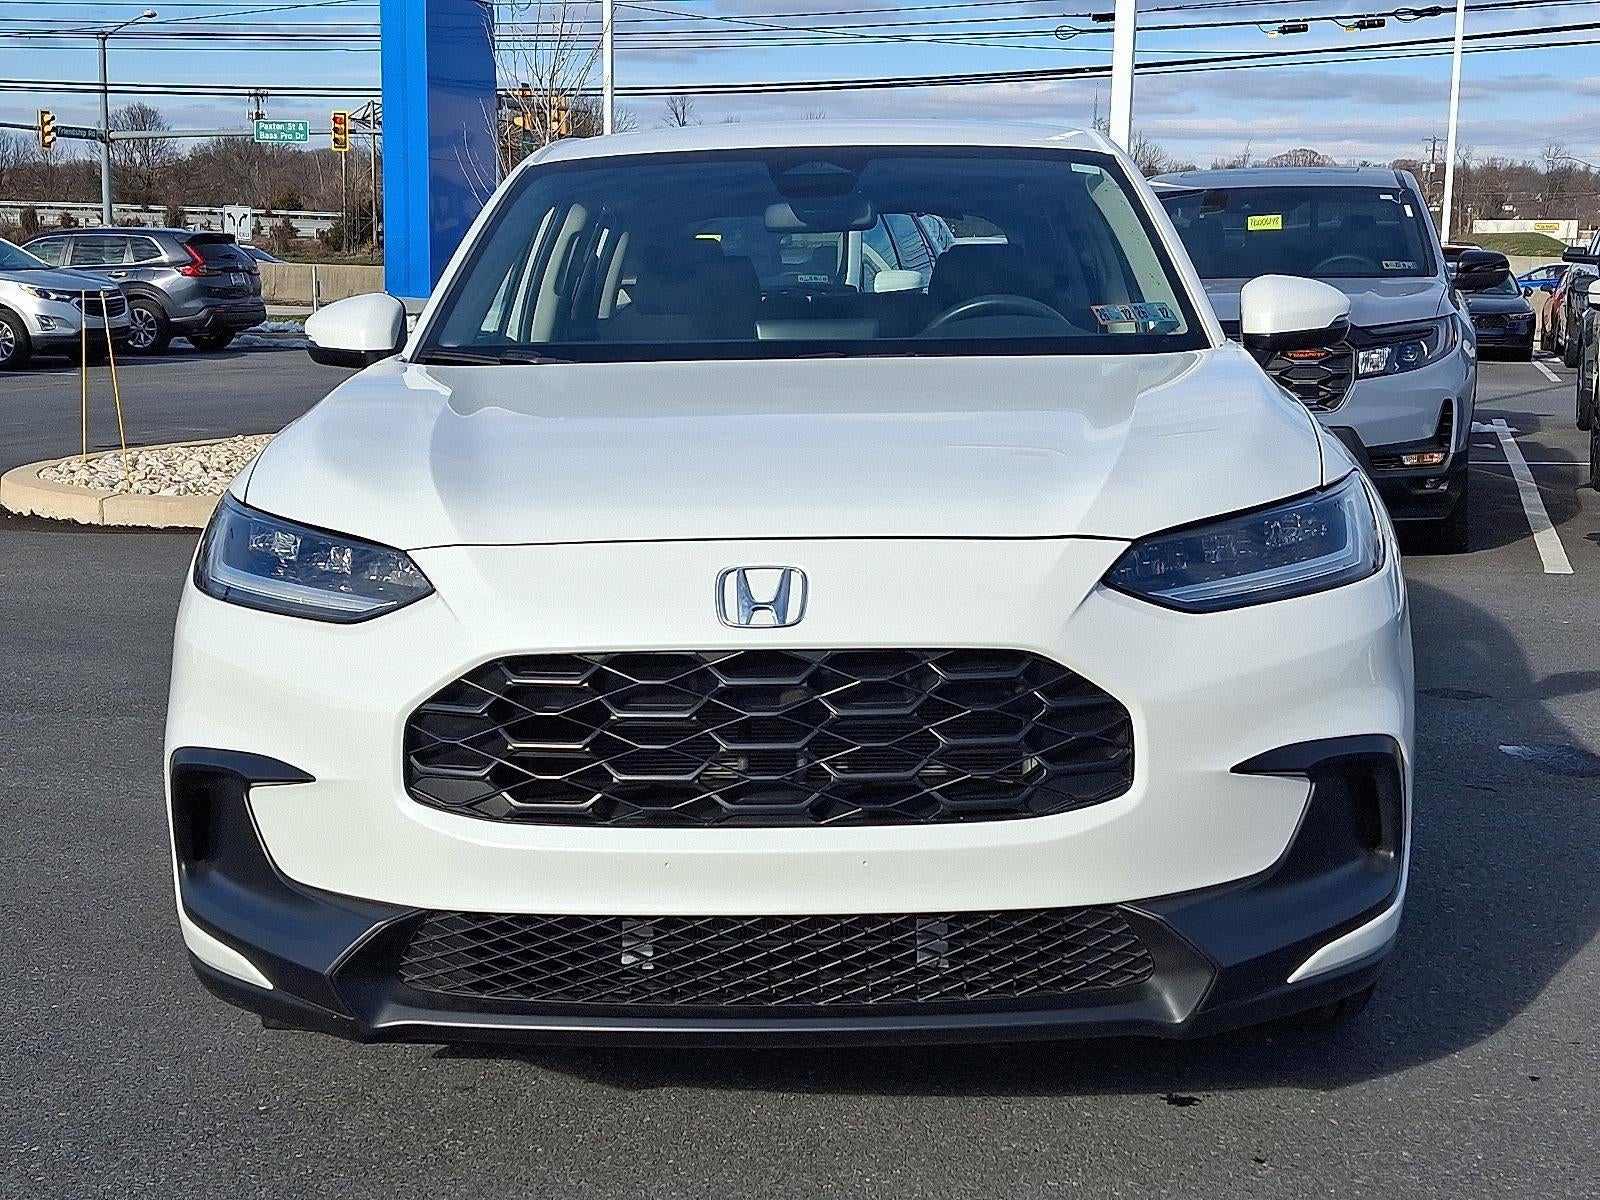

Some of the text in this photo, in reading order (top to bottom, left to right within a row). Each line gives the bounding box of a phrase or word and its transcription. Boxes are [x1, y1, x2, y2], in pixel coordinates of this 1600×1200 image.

[259, 122, 285, 130] Paxton
[287, 122, 296, 130] St
[57, 127, 96, 138] Friendship Rd
[259, 131, 305, 140] Bass Pro Dr
[1120, 308, 1135, 320] 12
[1157, 306, 1172, 319] 12
